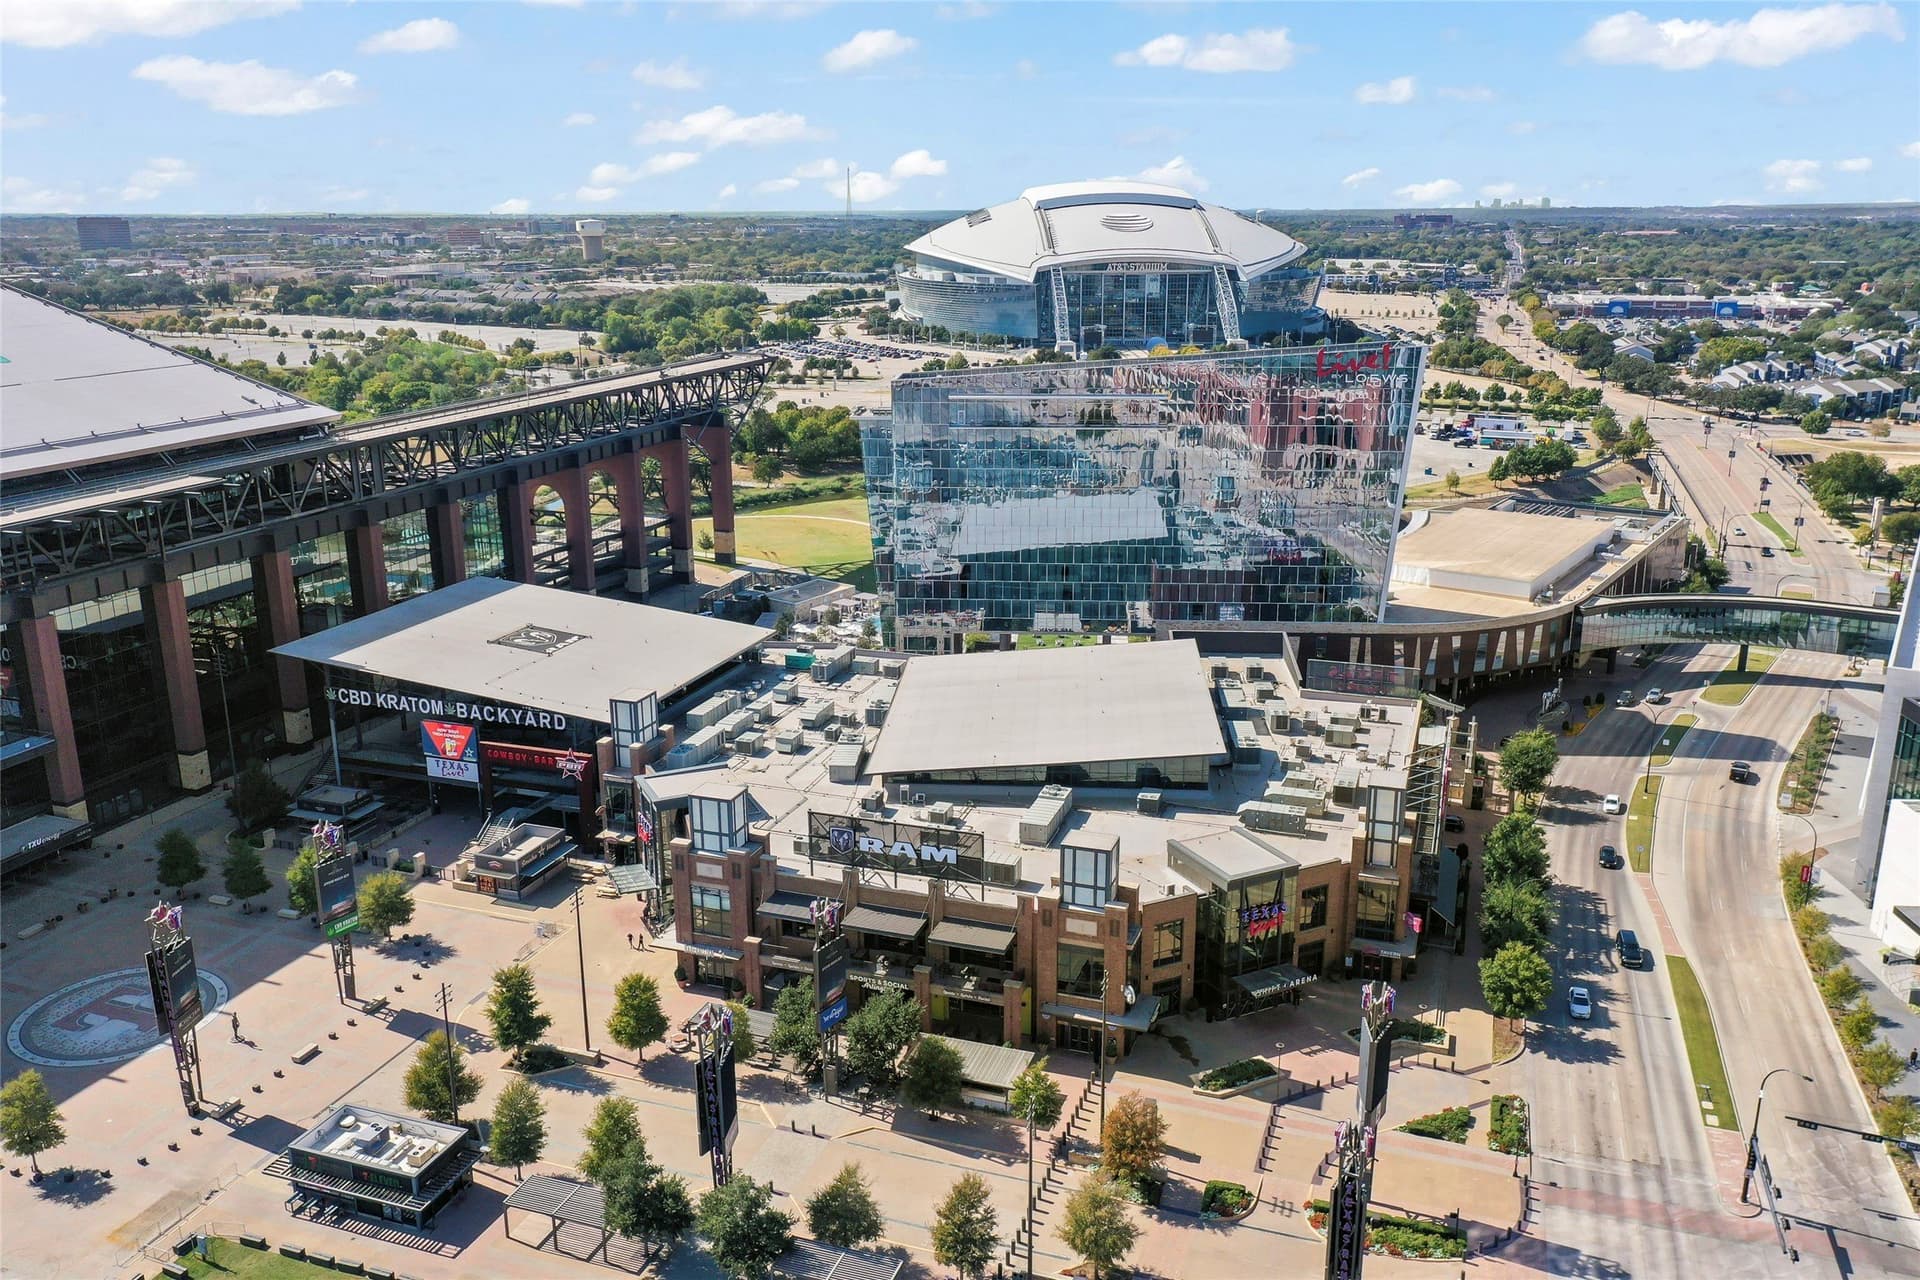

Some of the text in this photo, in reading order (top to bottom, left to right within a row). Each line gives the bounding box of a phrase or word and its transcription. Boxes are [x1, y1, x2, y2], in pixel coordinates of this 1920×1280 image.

[1106, 262, 1168, 272] AT&T STADIUM
[1345, 373, 1409, 384] LOEWS
[338, 688, 566, 730] CBD KRATOM BACKYARD
[488, 749, 527, 761] COWBOY
[534, 755, 555, 765] BAR
[435, 760, 469, 771] TEXAS
[859, 836, 957, 864] RAM
[1242, 902, 1288, 922] TEXAS
[849, 974, 876, 984] SPORTS
[883, 980, 909, 990] SOCIAL
[1289, 973, 1318, 988] ARENA
[1342, 1183, 1354, 1244] TEXAS
